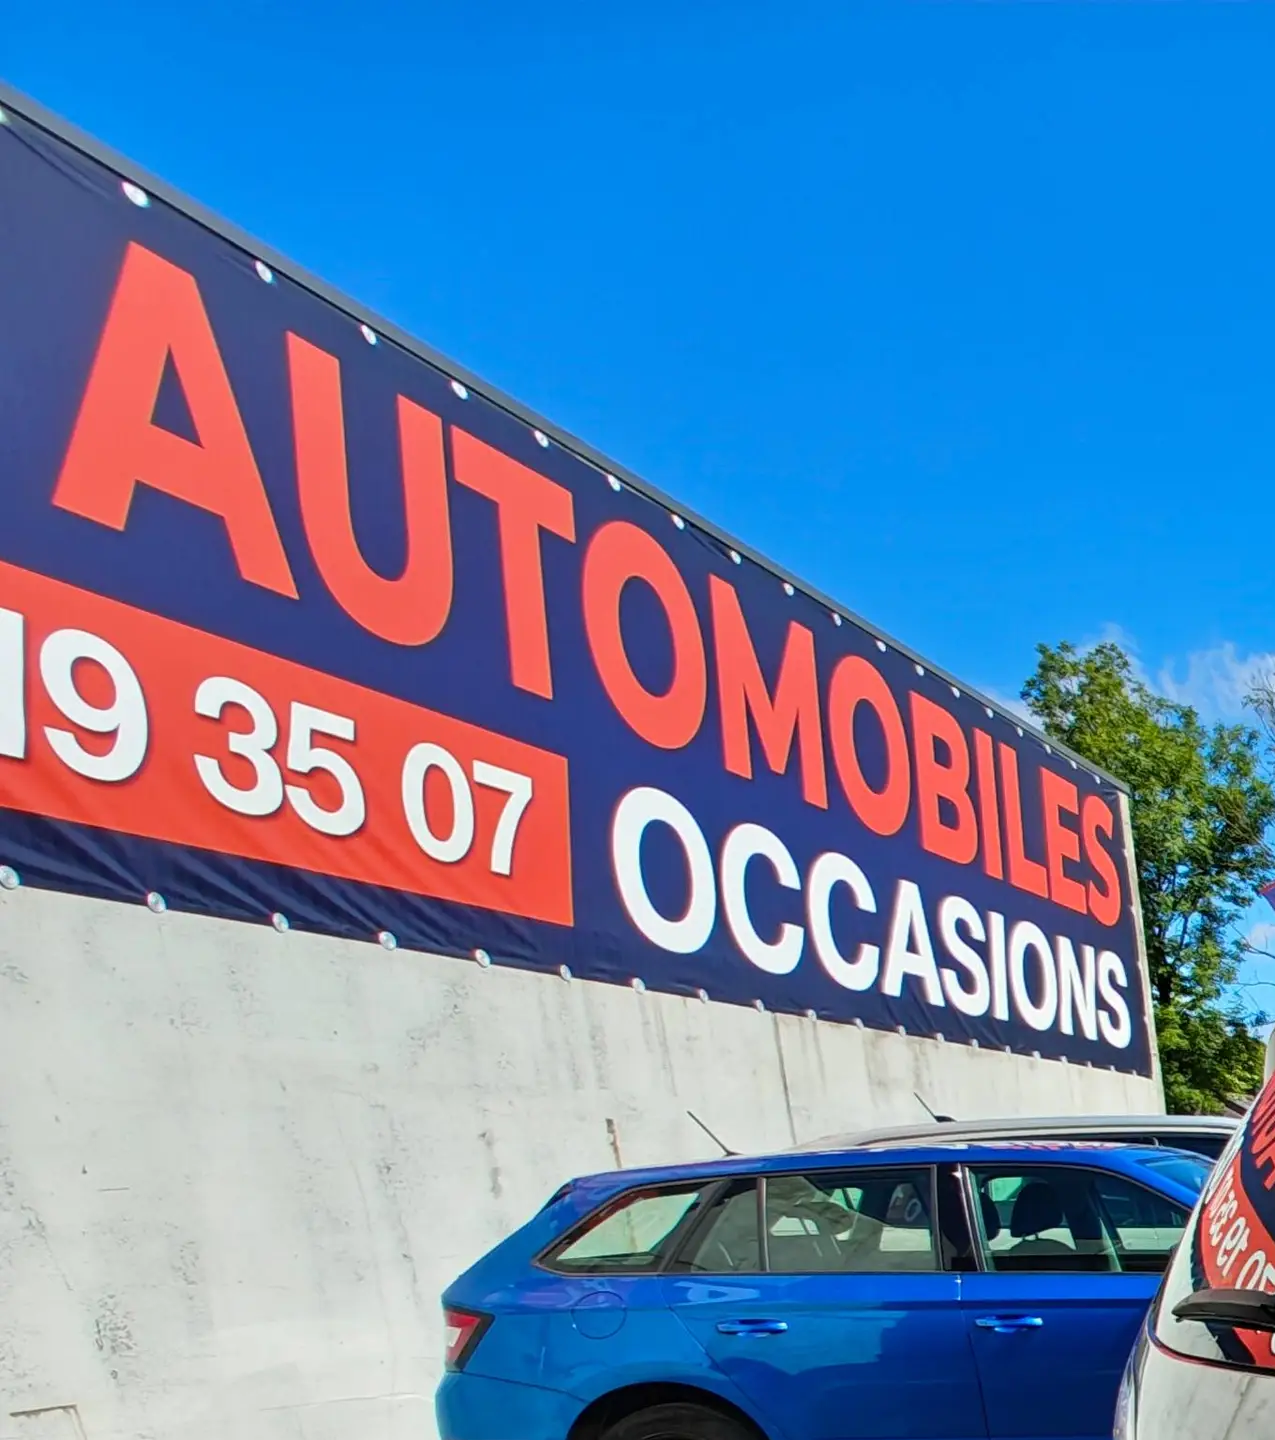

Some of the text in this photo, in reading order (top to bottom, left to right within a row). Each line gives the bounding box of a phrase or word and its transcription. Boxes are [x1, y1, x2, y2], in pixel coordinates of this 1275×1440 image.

[53, 241, 1122, 927] AUTOMOBILES
[193, 676, 366, 837] 35
[401, 740, 534, 877] 07
[612, 786, 1132, 1049] OCCASIONS
